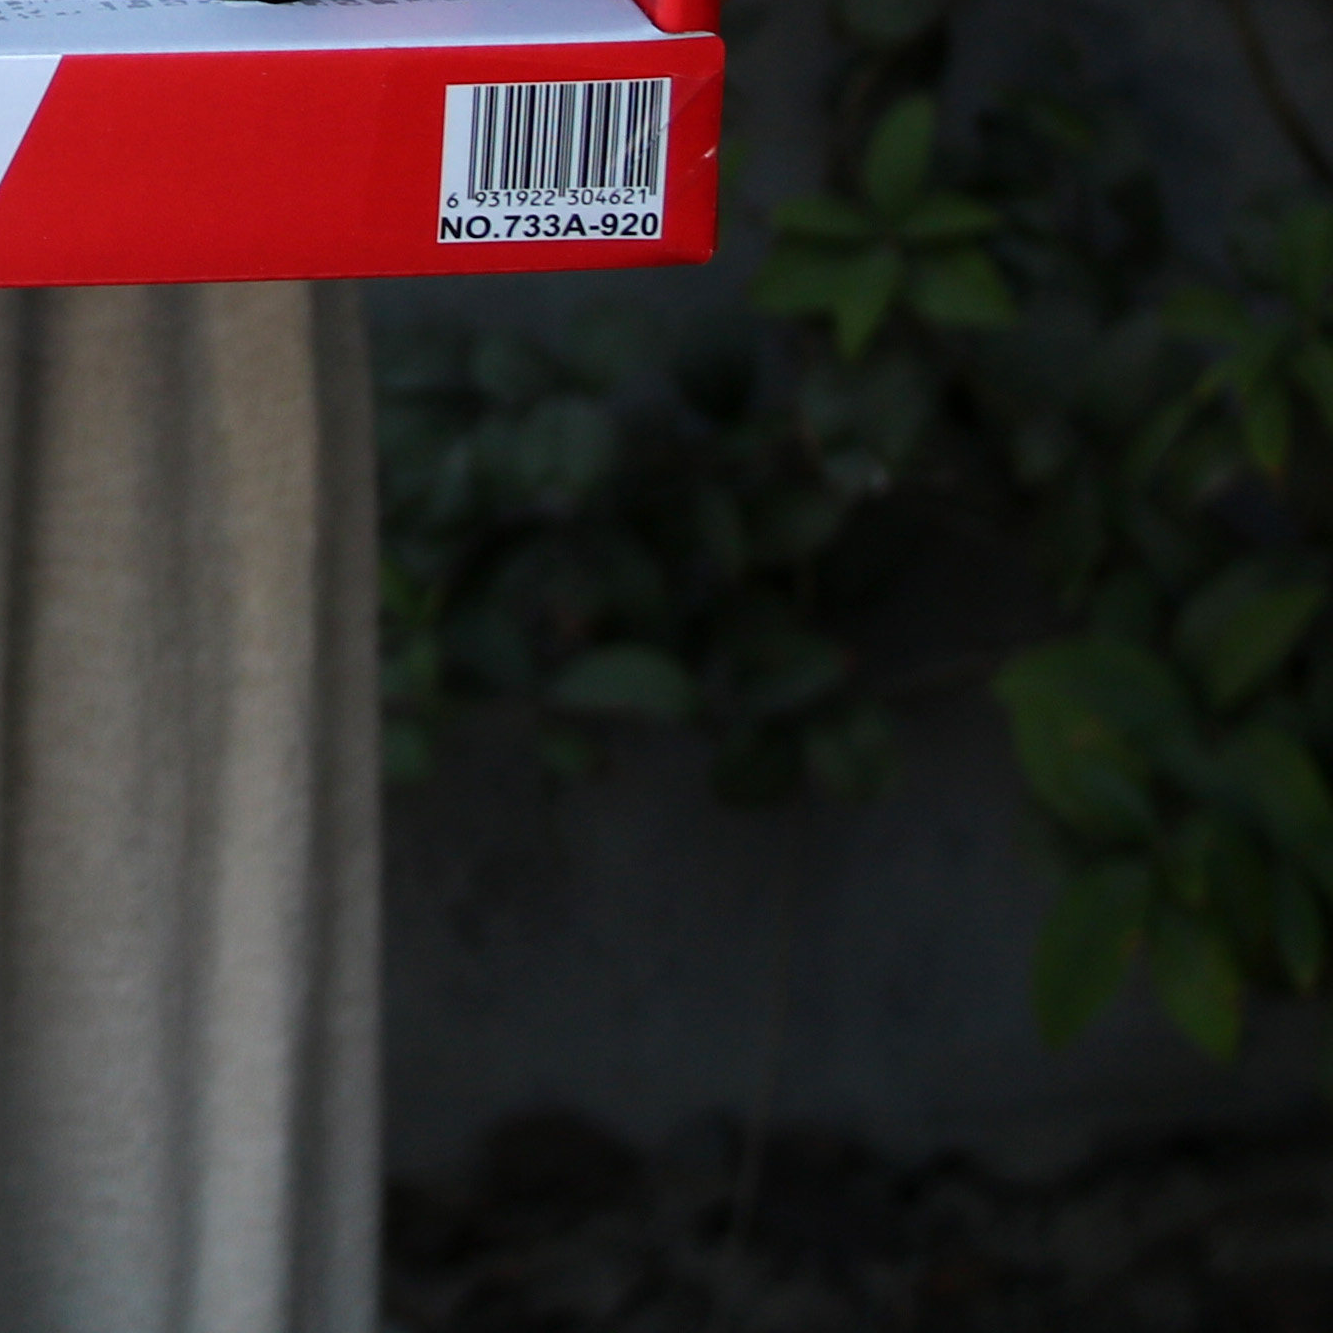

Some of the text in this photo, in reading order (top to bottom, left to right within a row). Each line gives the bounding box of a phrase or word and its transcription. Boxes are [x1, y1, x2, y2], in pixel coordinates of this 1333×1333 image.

[447, 188, 647, 208] 6 931922 304621
[440, 212, 659, 240] NO.733A-920
